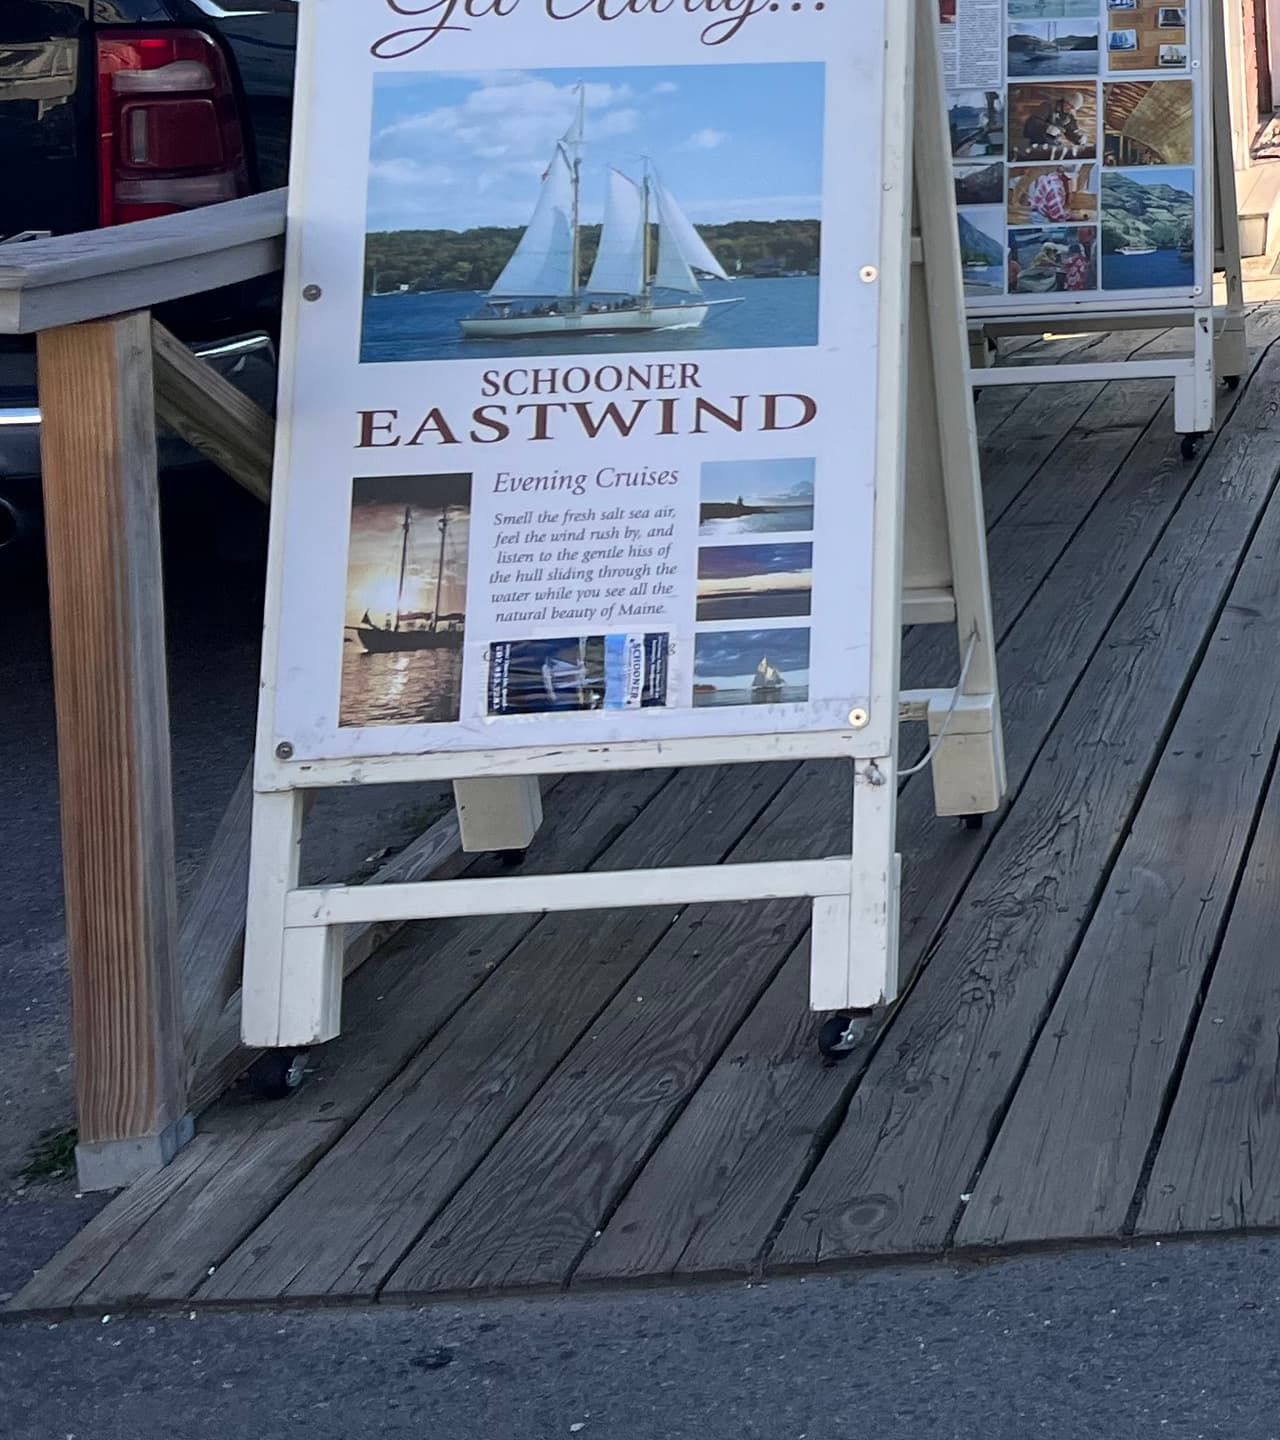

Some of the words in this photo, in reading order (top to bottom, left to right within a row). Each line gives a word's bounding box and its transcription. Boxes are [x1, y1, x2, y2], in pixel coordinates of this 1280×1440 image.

[481, 362, 702, 398] SCHOONER
[353, 393, 819, 449] EASTWIND
[493, 470, 588, 496] Evening
[596, 466, 680, 489] Cruises
[493, 511, 534, 527] Smell
[537, 511, 560, 525] the
[561, 509, 597, 527] fresh
[600, 507, 625, 521] salt
[628, 509, 651, 520] sea
[654, 505, 677, 520] air,
[494, 531, 521, 549] feel
[524, 530, 548, 544] the
[550, 528, 587, 543] wind
[590, 526, 620, 541] rush
[624, 526, 643, 543] by,
[647, 524, 675, 538] and
[497, 551, 535, 565] listen
[539, 552, 553, 563] to
[556, 548, 580, 563] the
[582, 545, 625, 565] gentle
[628, 544, 654, 559] hiss
[657, 541, 674, 558] of
[489, 571, 512, 585] the
[515, 569, 544, 583] hull
[547, 567, 595, 584] sliding
[598, 564, 651, 581] through
[655, 562, 679, 576] the
[491, 591, 531, 604] water
[535, 587, 574, 602] while
[576, 587, 601, 603] you
[605, 586, 626, 598] see
[629, 583, 648, 597] all
[651, 582, 675, 596] the
[496, 607, 547, 624] natural
[551, 607, 597, 623] beauty
[600, 602, 617, 621] of
[628, 642, 642, 700] SCHOONER
